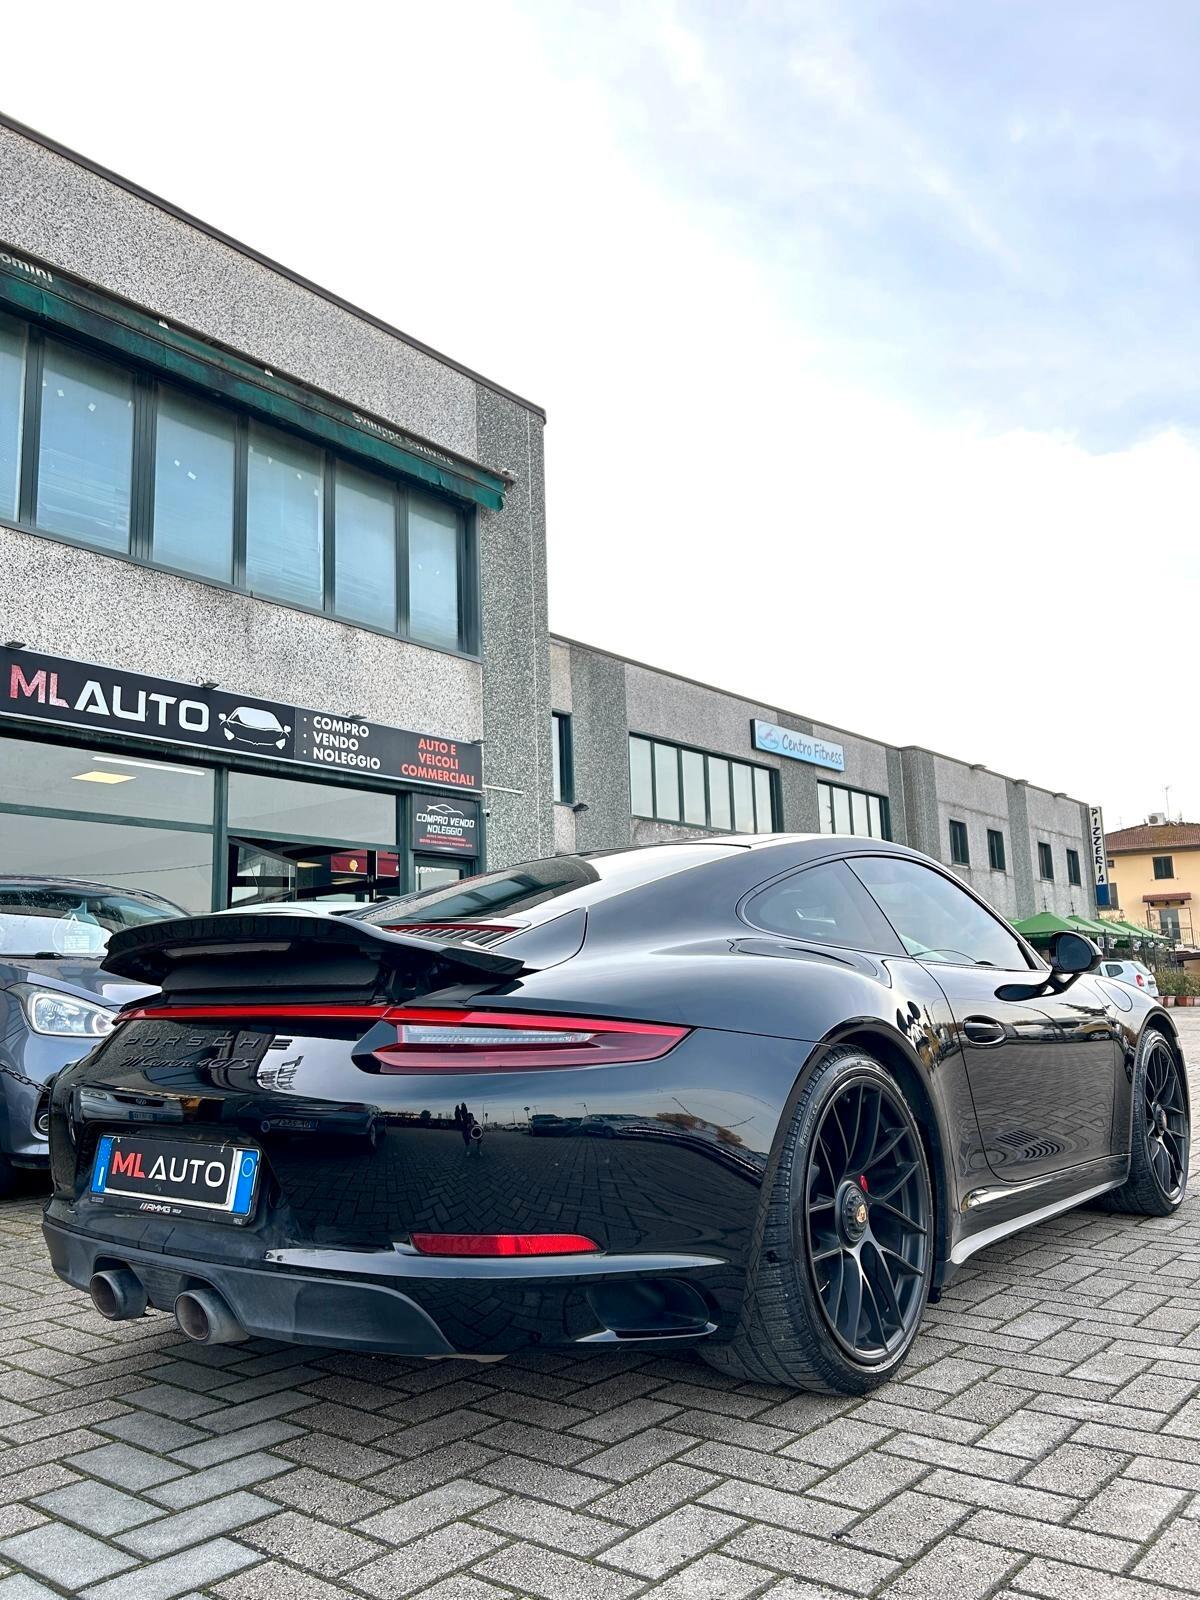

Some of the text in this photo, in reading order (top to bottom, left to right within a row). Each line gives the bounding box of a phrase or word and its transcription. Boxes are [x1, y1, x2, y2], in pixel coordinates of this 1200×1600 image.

[74, 680, 209, 732] AUTO
[313, 716, 369, 738] COMPRO
[313, 731, 359, 750] VENDO
[418, 738, 456, 756] AUTO E
[782, 734, 842, 765] Centro Fitness
[313, 747, 381, 770] NOLEGGIO
[418, 752, 459, 770] VEICOLI
[401, 763, 475, 786] COMMERCIALI
[416, 813, 475, 828] COMPRO VENDO
[427, 825, 463, 836] NOLEGGIO
[1090, 808, 1105, 883] PIZZERIA
[123, 1036, 293, 1051] PORSCHE
[111, 1151, 226, 1188] ML AUTO
